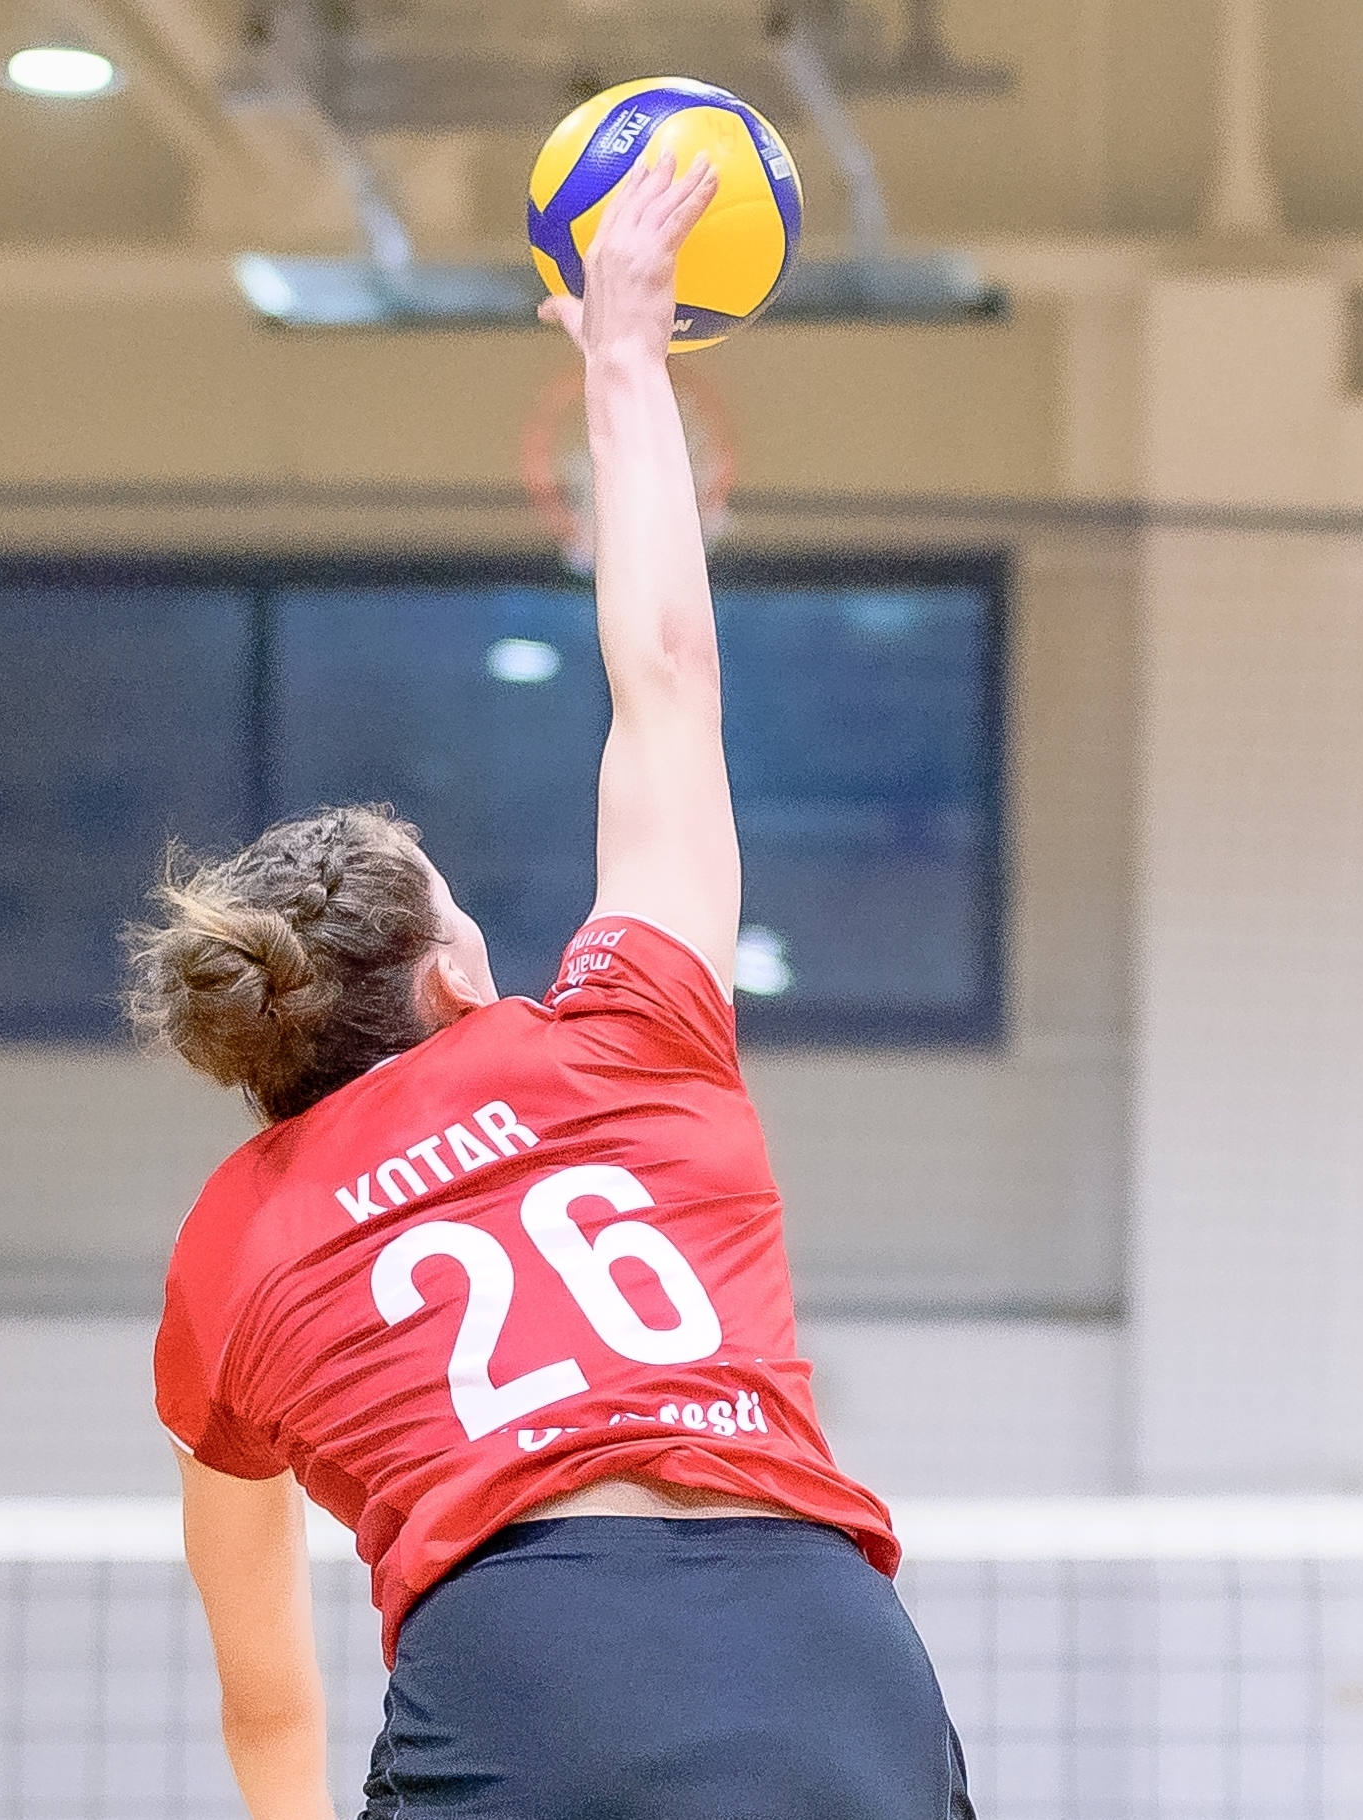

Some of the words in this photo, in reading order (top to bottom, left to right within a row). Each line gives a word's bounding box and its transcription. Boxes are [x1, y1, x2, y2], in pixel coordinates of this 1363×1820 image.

[613, 112, 651, 154] FIVB
[569, 928, 627, 957] print
[567, 952, 612, 976] mark
[334, 1099, 541, 1224] KOTAR
[370, 1164, 723, 1442] 26
